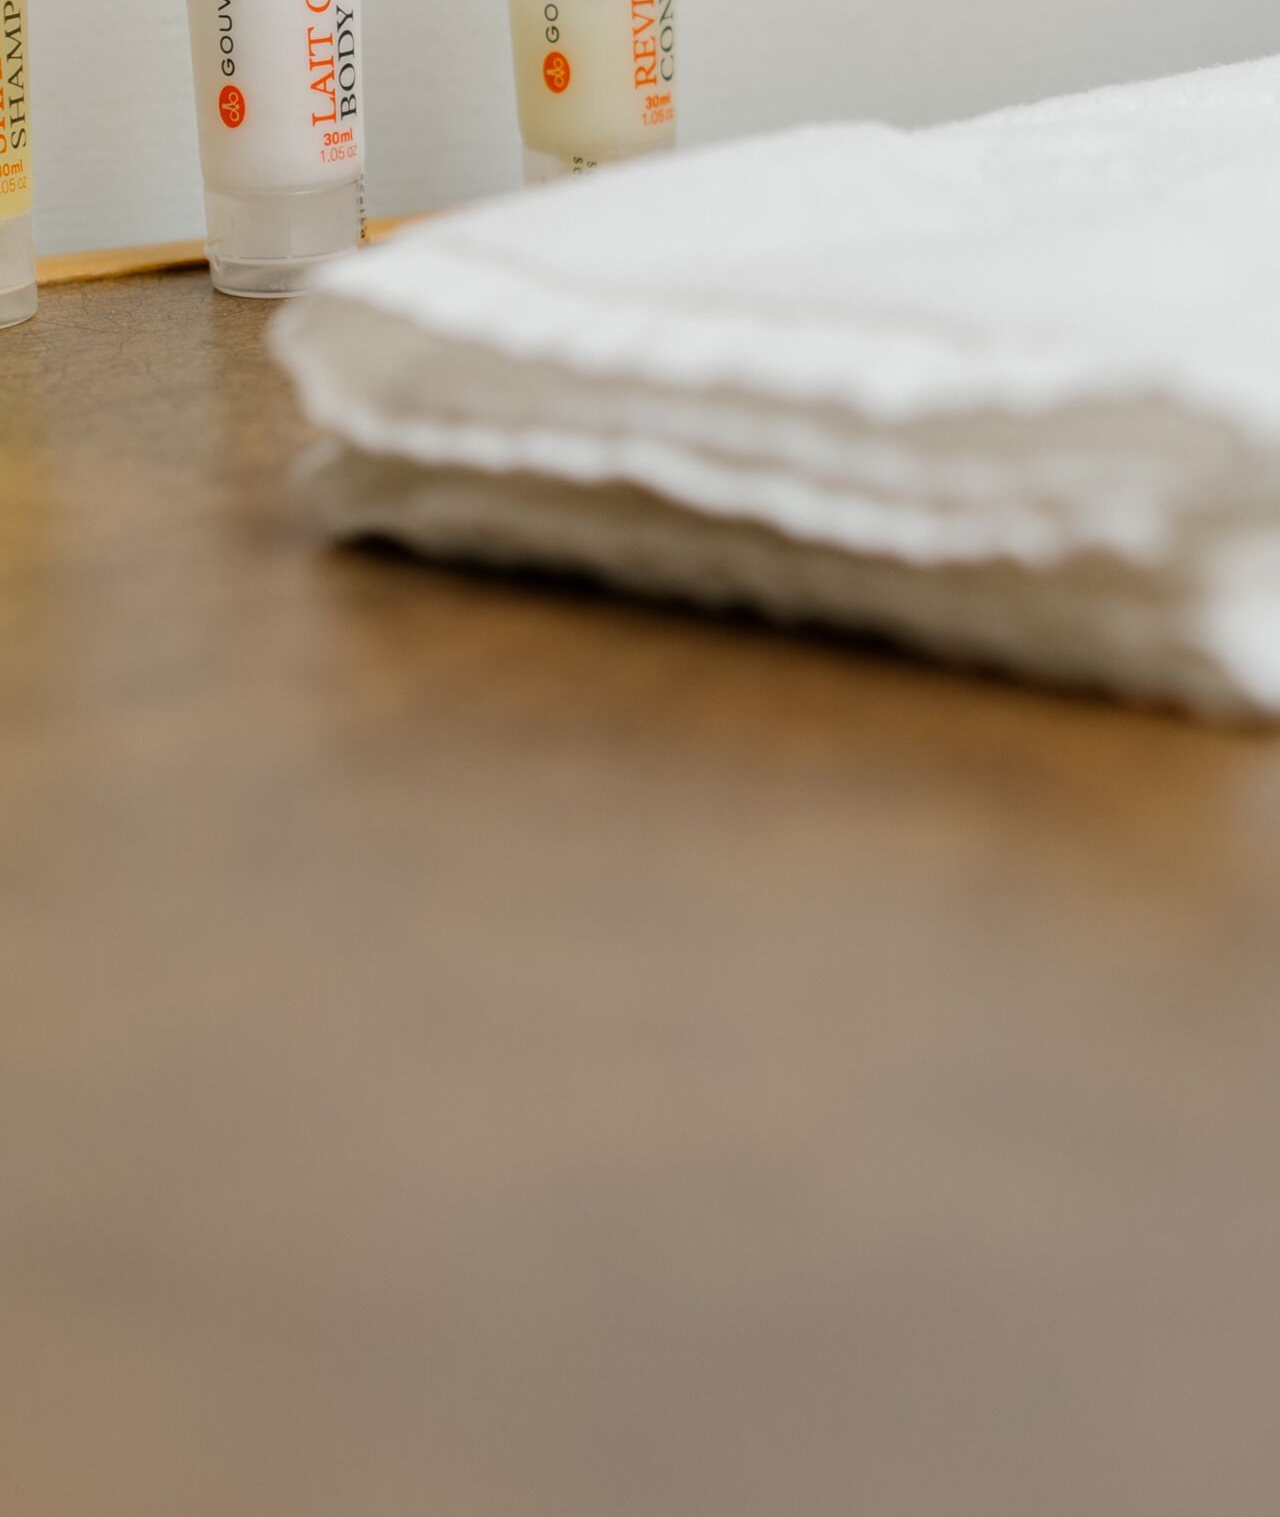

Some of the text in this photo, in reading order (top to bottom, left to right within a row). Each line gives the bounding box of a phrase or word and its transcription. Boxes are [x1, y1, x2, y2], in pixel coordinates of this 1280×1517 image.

[307, 27, 337, 127] LAIT
[337, 5, 357, 120] BODY
[320, 144, 357, 163] 1.05 oz
[323, 127, 352, 146] 30ml
